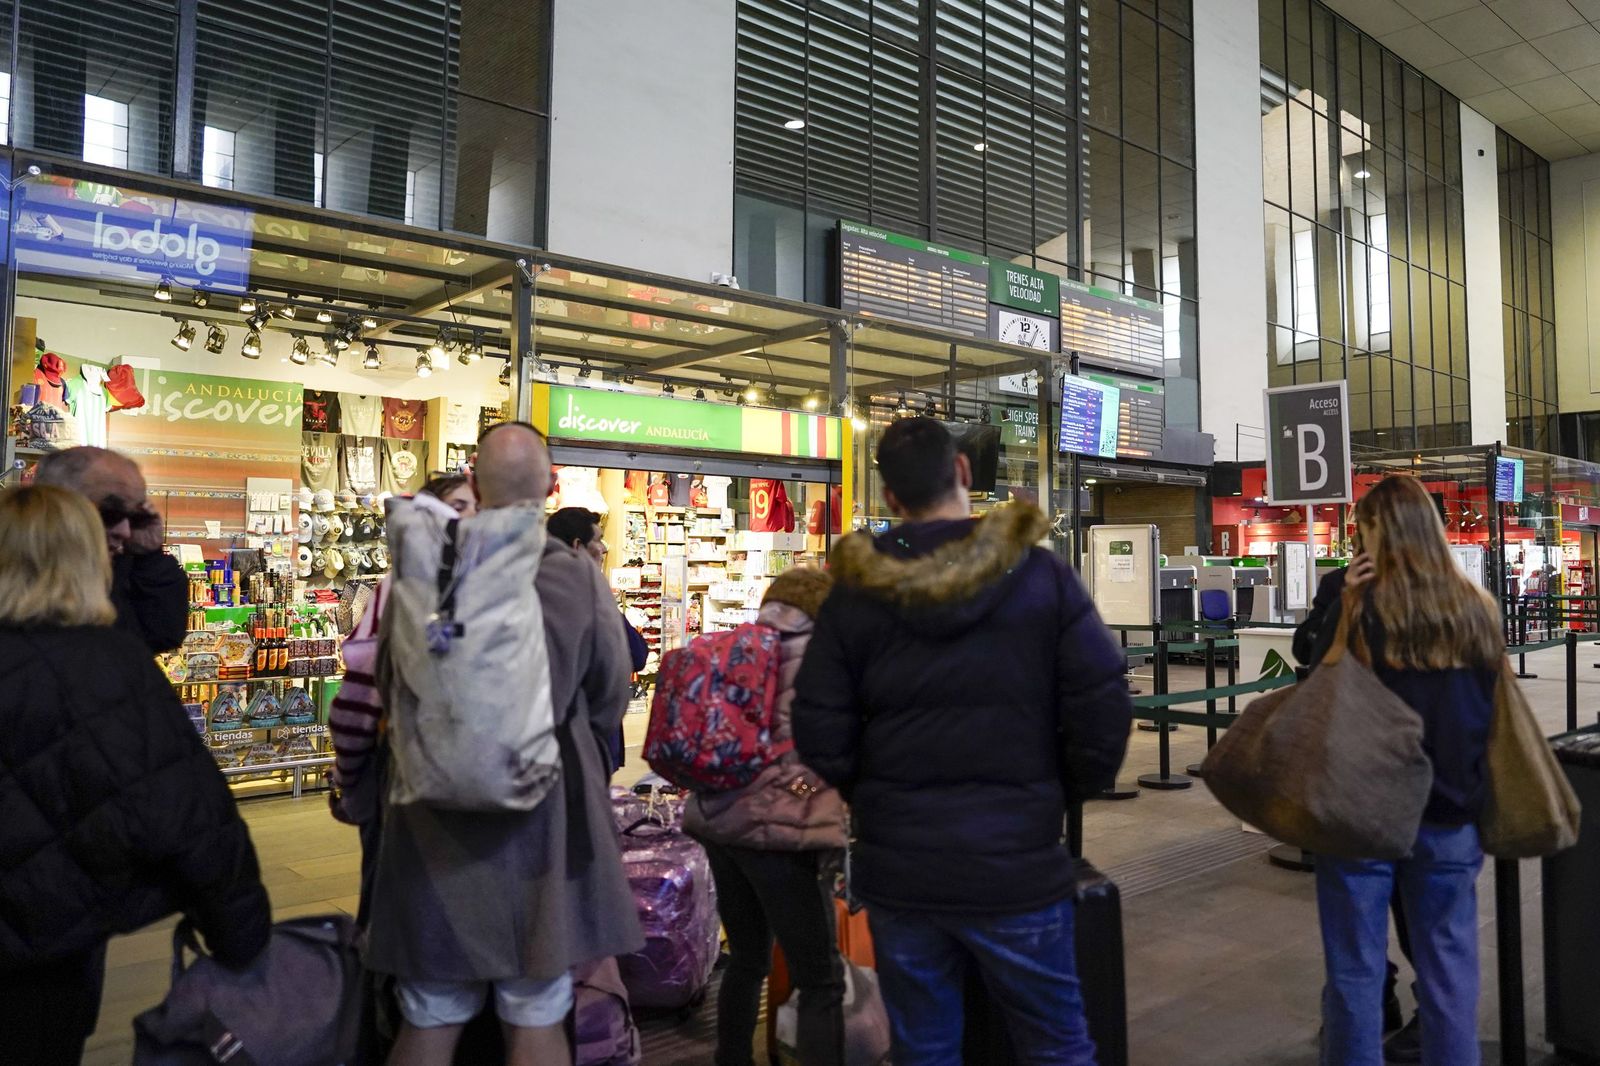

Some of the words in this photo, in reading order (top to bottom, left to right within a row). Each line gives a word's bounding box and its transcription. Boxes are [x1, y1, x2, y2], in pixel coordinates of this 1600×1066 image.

[1006, 270, 1029, 287] TRENES
[1029, 276, 1045, 291] ALTA
[1009, 284, 1042, 303] VELOCIDAD
[1020, 321, 1031, 334] 12
[185, 383, 304, 404] ANDALUCÍA
[1309, 398, 1339, 409] Acceso
[558, 394, 642, 435] discover
[645, 424, 710, 441] ANDALUCÍA
[1007, 409, 1024, 423] HIGH
[1025, 411, 1039, 425] SPEE
[1014, 424, 1036, 438] TRAINS
[300, 445, 332, 458] SEVILLA
[1297, 423, 1328, 491] B
[750, 489, 769, 520] 19
[214, 731, 253, 741] tiendas
[292, 724, 328, 735] tiendas
